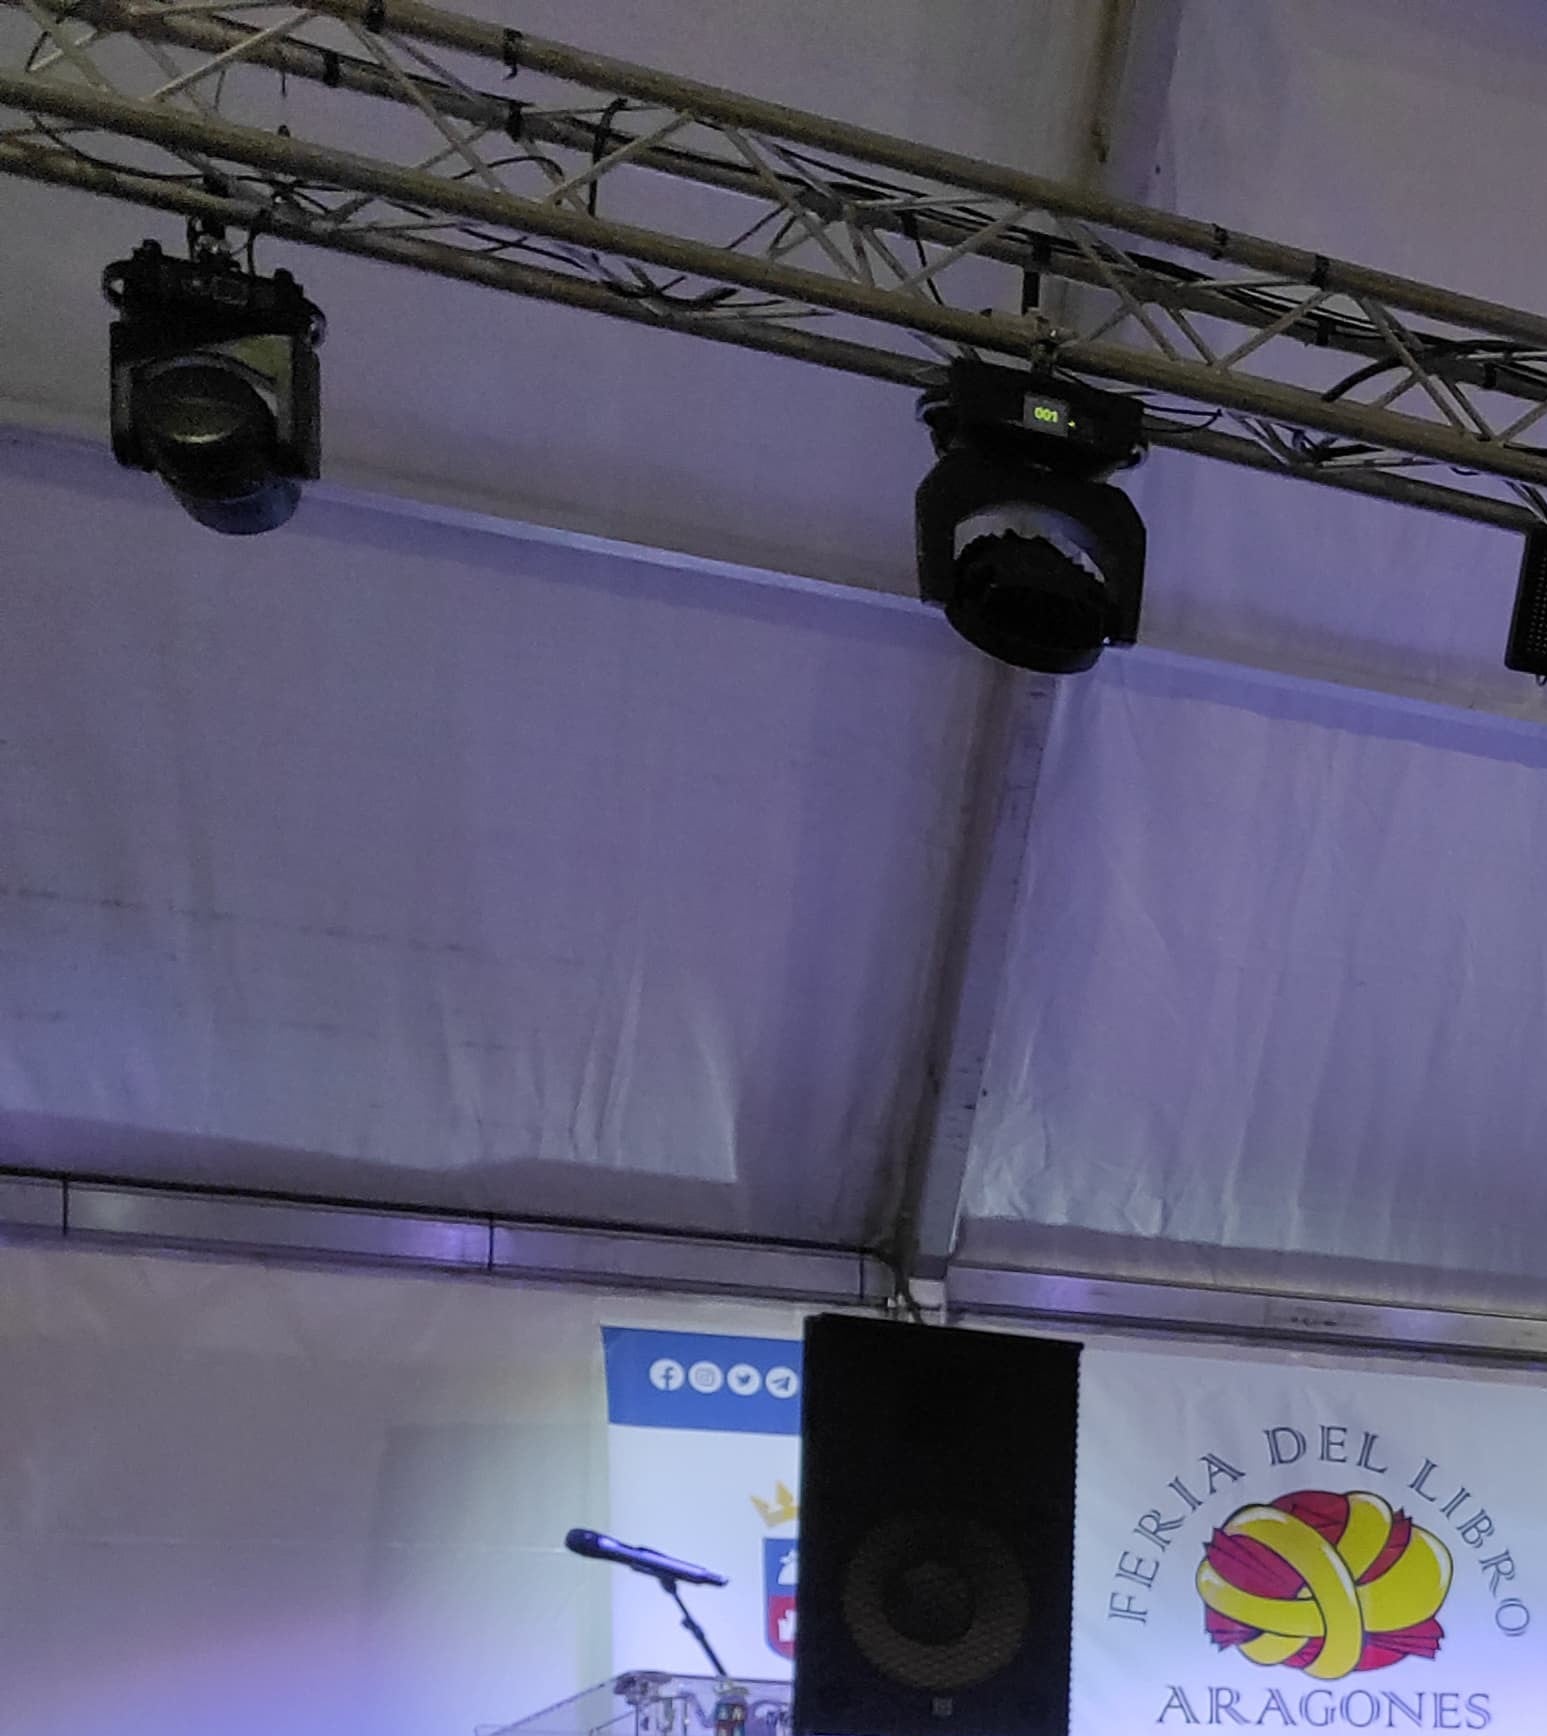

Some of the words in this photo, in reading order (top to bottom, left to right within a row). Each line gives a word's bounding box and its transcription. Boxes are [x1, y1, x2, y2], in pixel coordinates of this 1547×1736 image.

[1108, 1451, 1246, 1625] FERIA
[1264, 1423, 1390, 1475] DEL
[1408, 1456, 1532, 1638] LIBRO
[1156, 1684, 1493, 1731] ARAGONES
